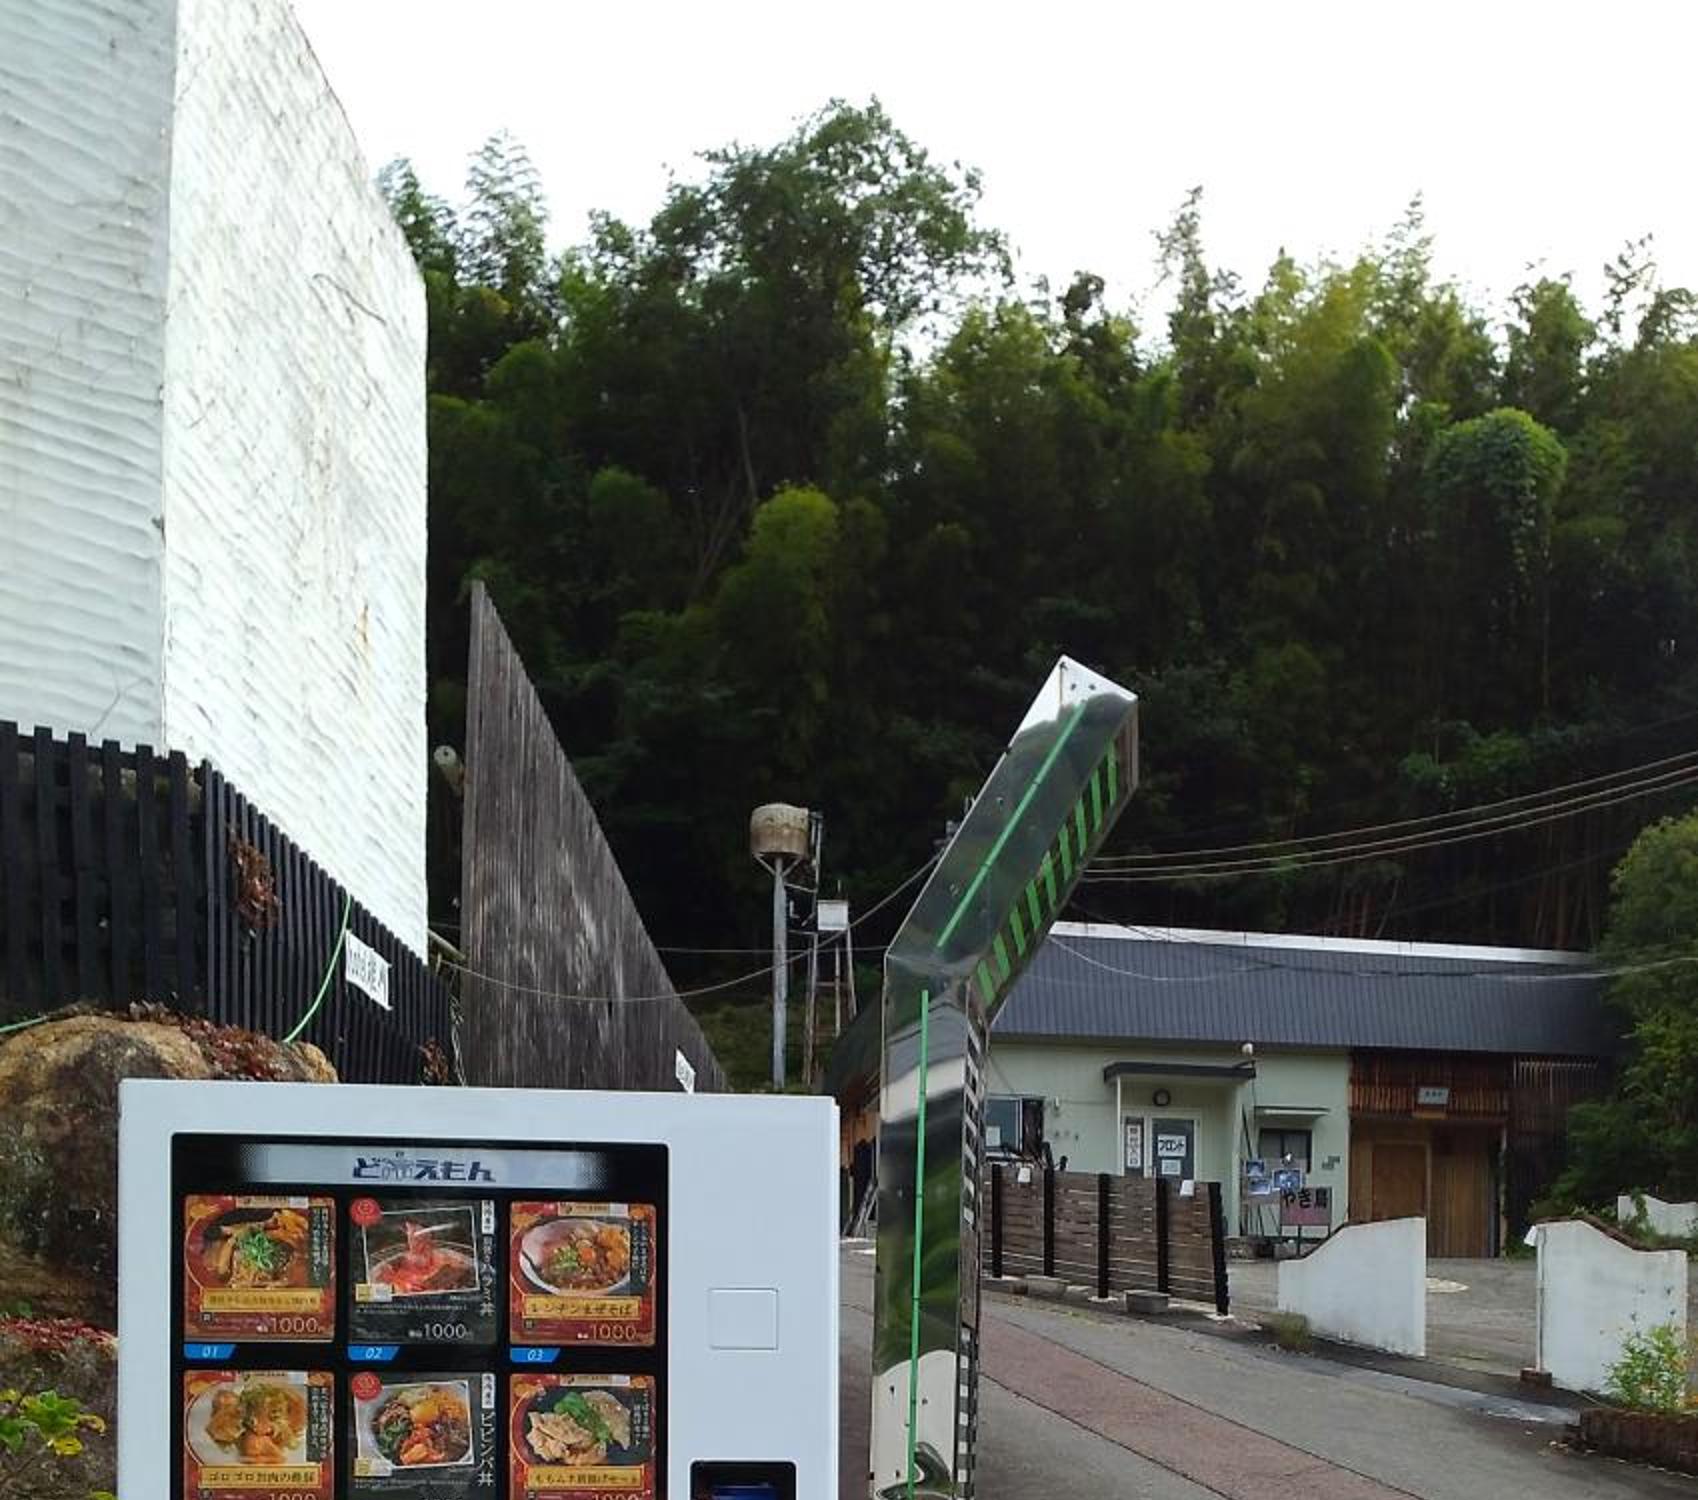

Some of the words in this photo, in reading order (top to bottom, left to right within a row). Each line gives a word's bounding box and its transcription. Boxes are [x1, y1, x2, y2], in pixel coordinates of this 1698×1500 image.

[202, 1346, 218, 1358] 01
[365, 1347, 383, 1360] 02
[526, 1349, 544, 1361] 03
